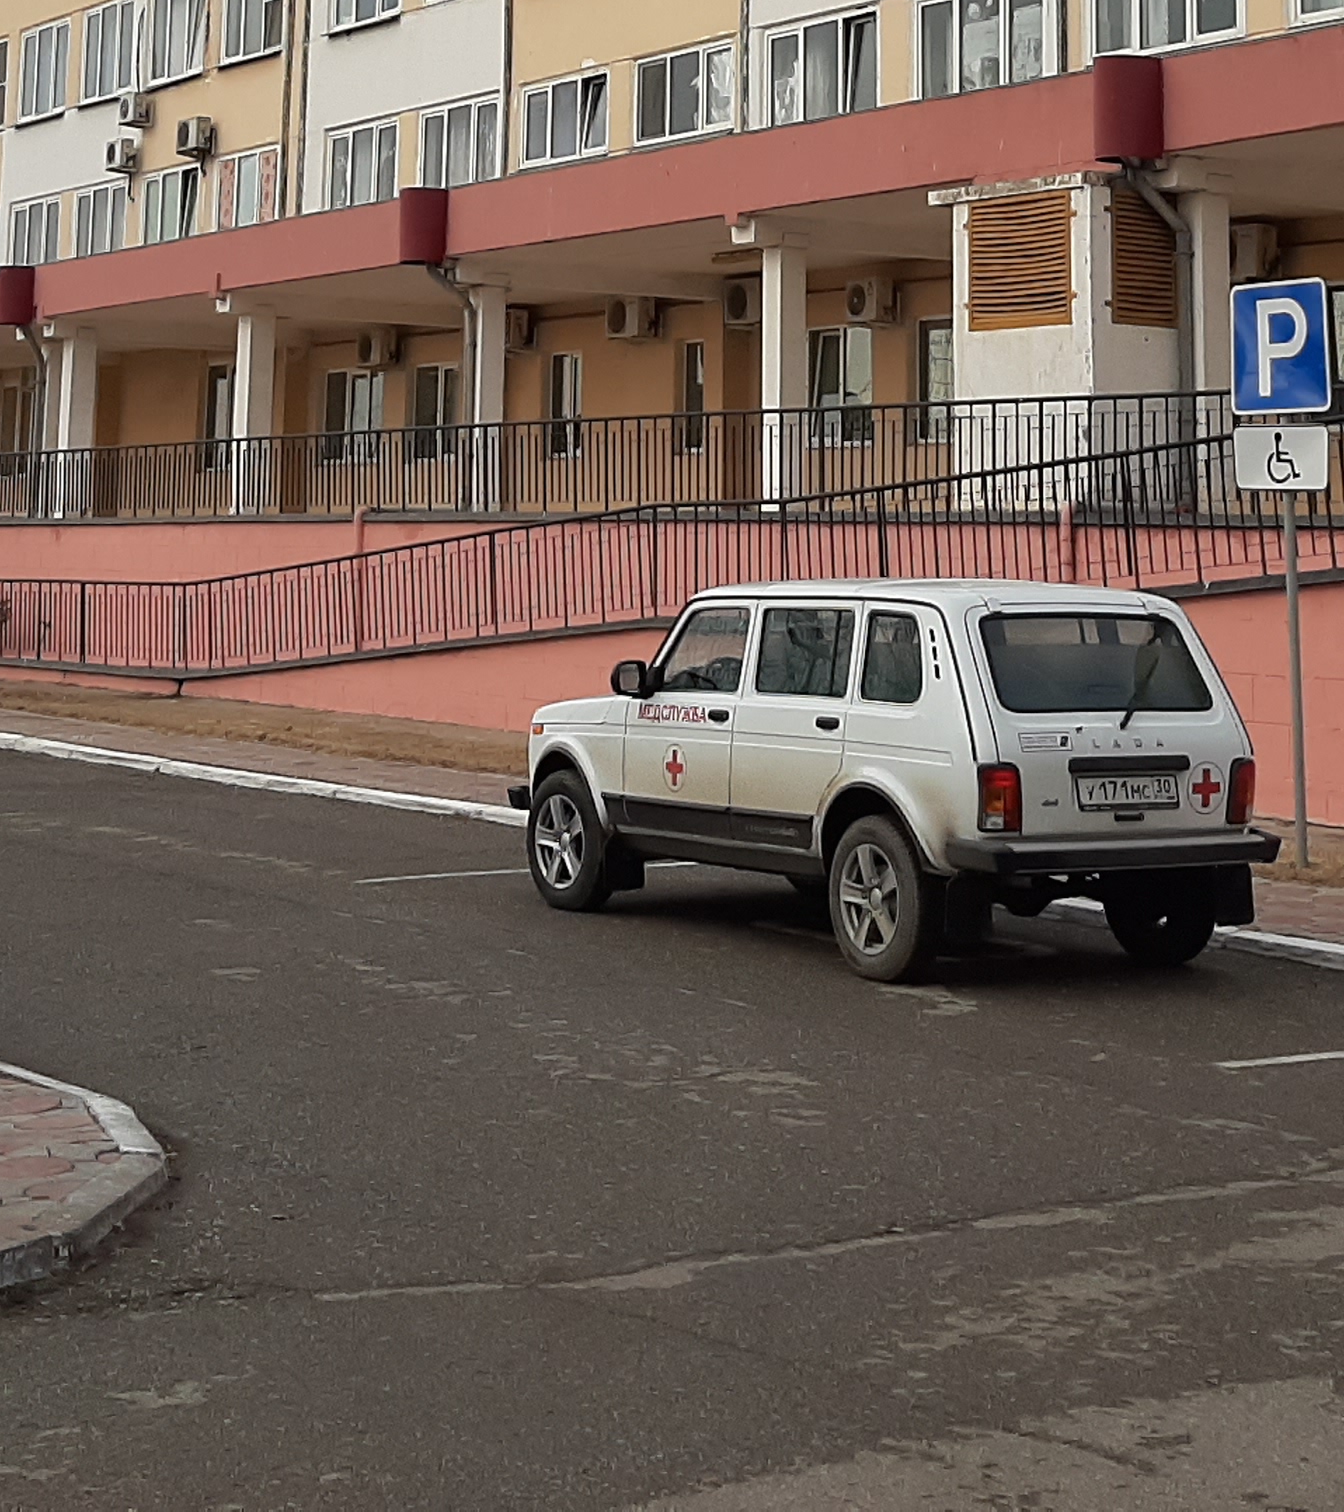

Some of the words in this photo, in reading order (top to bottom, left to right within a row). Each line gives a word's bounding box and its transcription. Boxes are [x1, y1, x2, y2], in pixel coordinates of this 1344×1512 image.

[1256, 297, 1307, 397] P
[1091, 738, 1164, 749] LADA
[1156, 779, 1171, 793] 30
